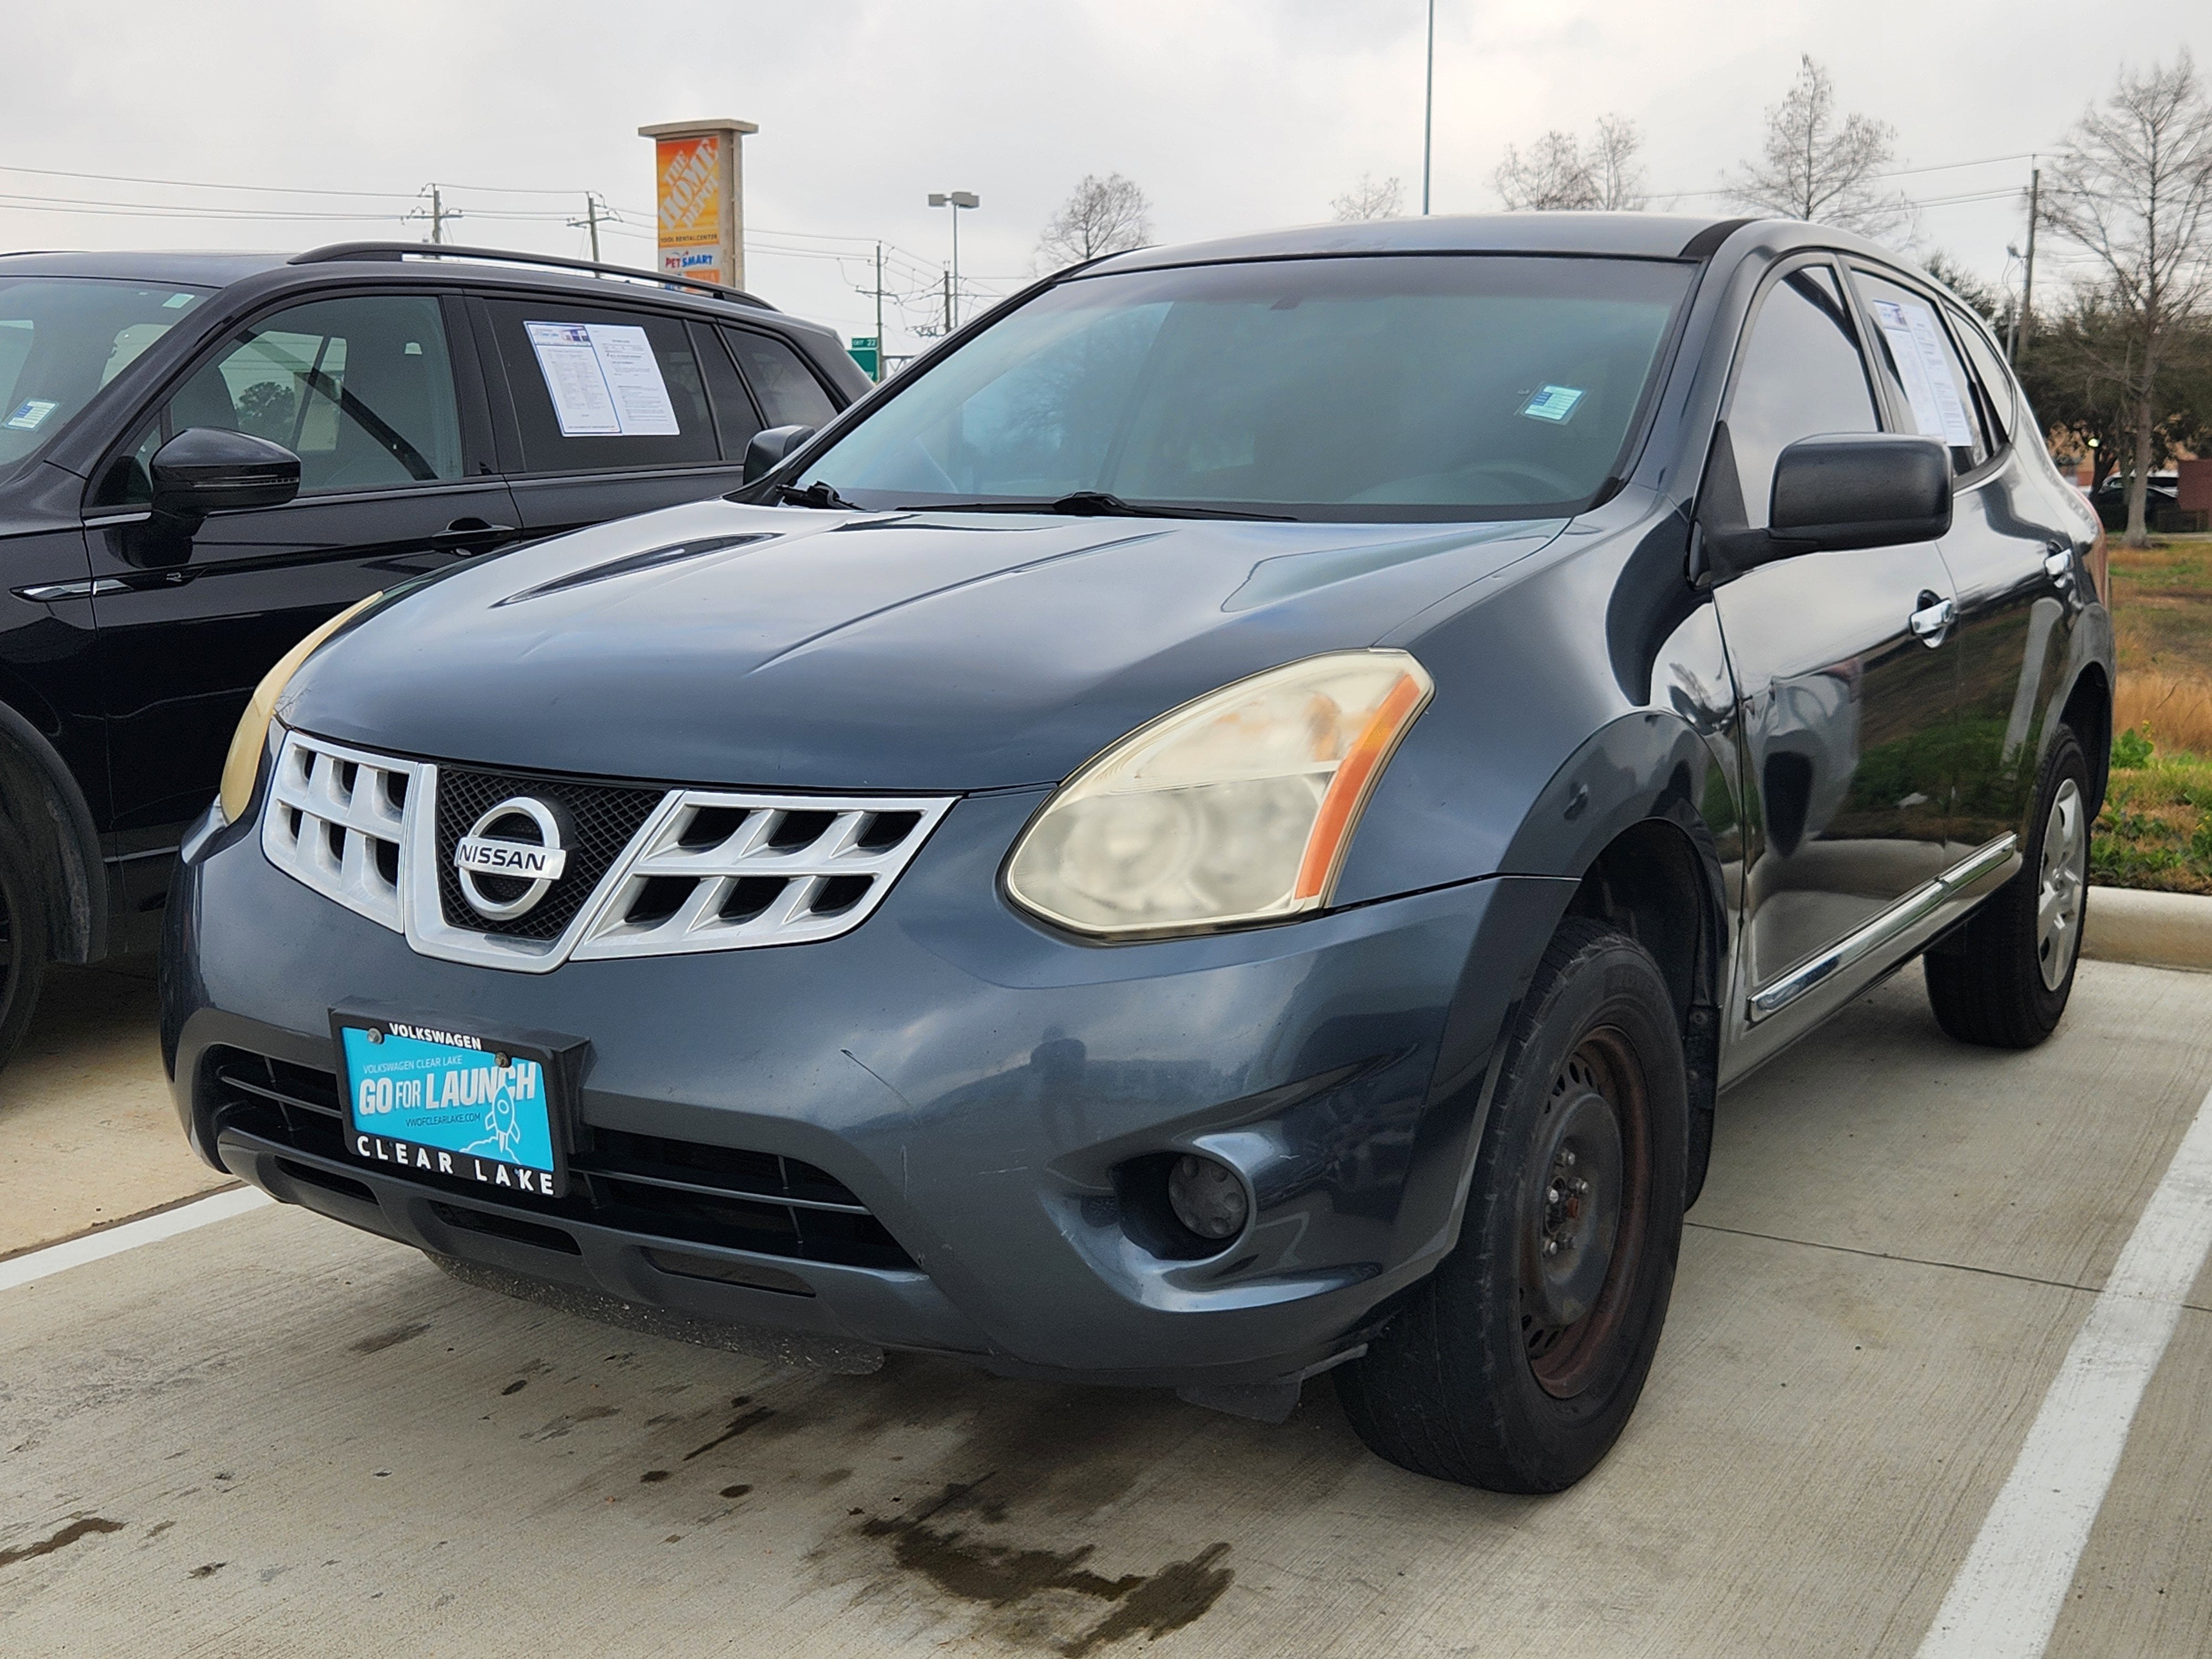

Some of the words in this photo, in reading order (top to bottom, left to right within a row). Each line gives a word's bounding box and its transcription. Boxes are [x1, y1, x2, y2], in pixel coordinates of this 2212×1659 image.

[659, 138, 718, 230] HOME
[664, 149, 688, 185] THE
[682, 174, 718, 228] DEPOT
[458, 844, 546, 871] NISSAN
[389, 1022, 481, 1050] VOLKSWAGEN
[363, 1060, 414, 1074] VOLKSWAGEN
[416, 1057, 441, 1070] CLEAR
[442, 1055, 463, 1066] LAKE
[359, 1077, 393, 1115] GO
[395, 1079, 421, 1109] FOR
[425, 1061, 537, 1109] LAUNCH
[405, 1112, 481, 1128] VWOFCLEARLAKE.COM
[357, 1135, 453, 1175] CLEAR
[474, 1159, 555, 1196] LAKE
